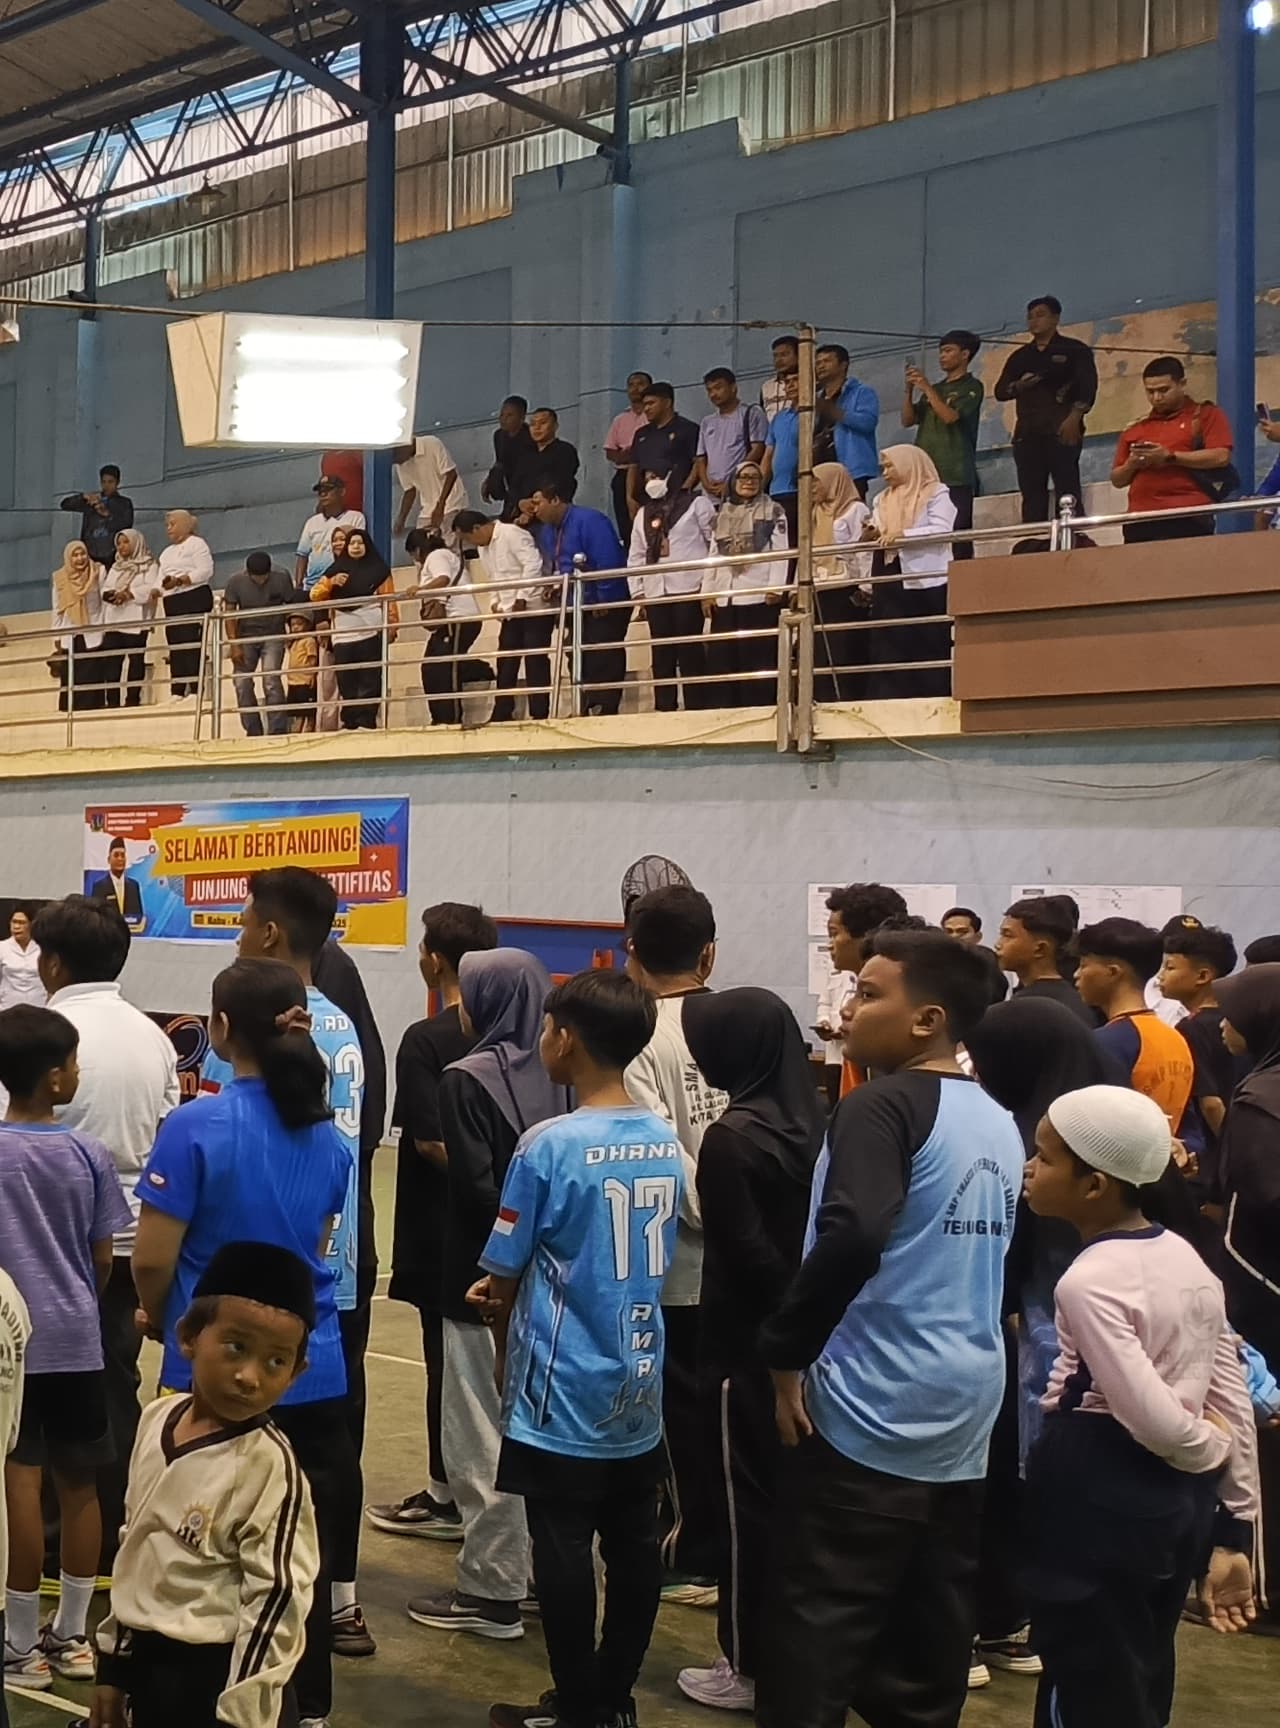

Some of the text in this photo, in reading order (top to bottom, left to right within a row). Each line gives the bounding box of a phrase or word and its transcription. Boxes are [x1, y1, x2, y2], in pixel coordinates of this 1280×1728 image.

[164, 825, 358, 864] SELAMAT BERTANDING!
[190, 870, 392, 901] JUNJUNG RTIFITAS
[602, 1174, 677, 1281] 17
